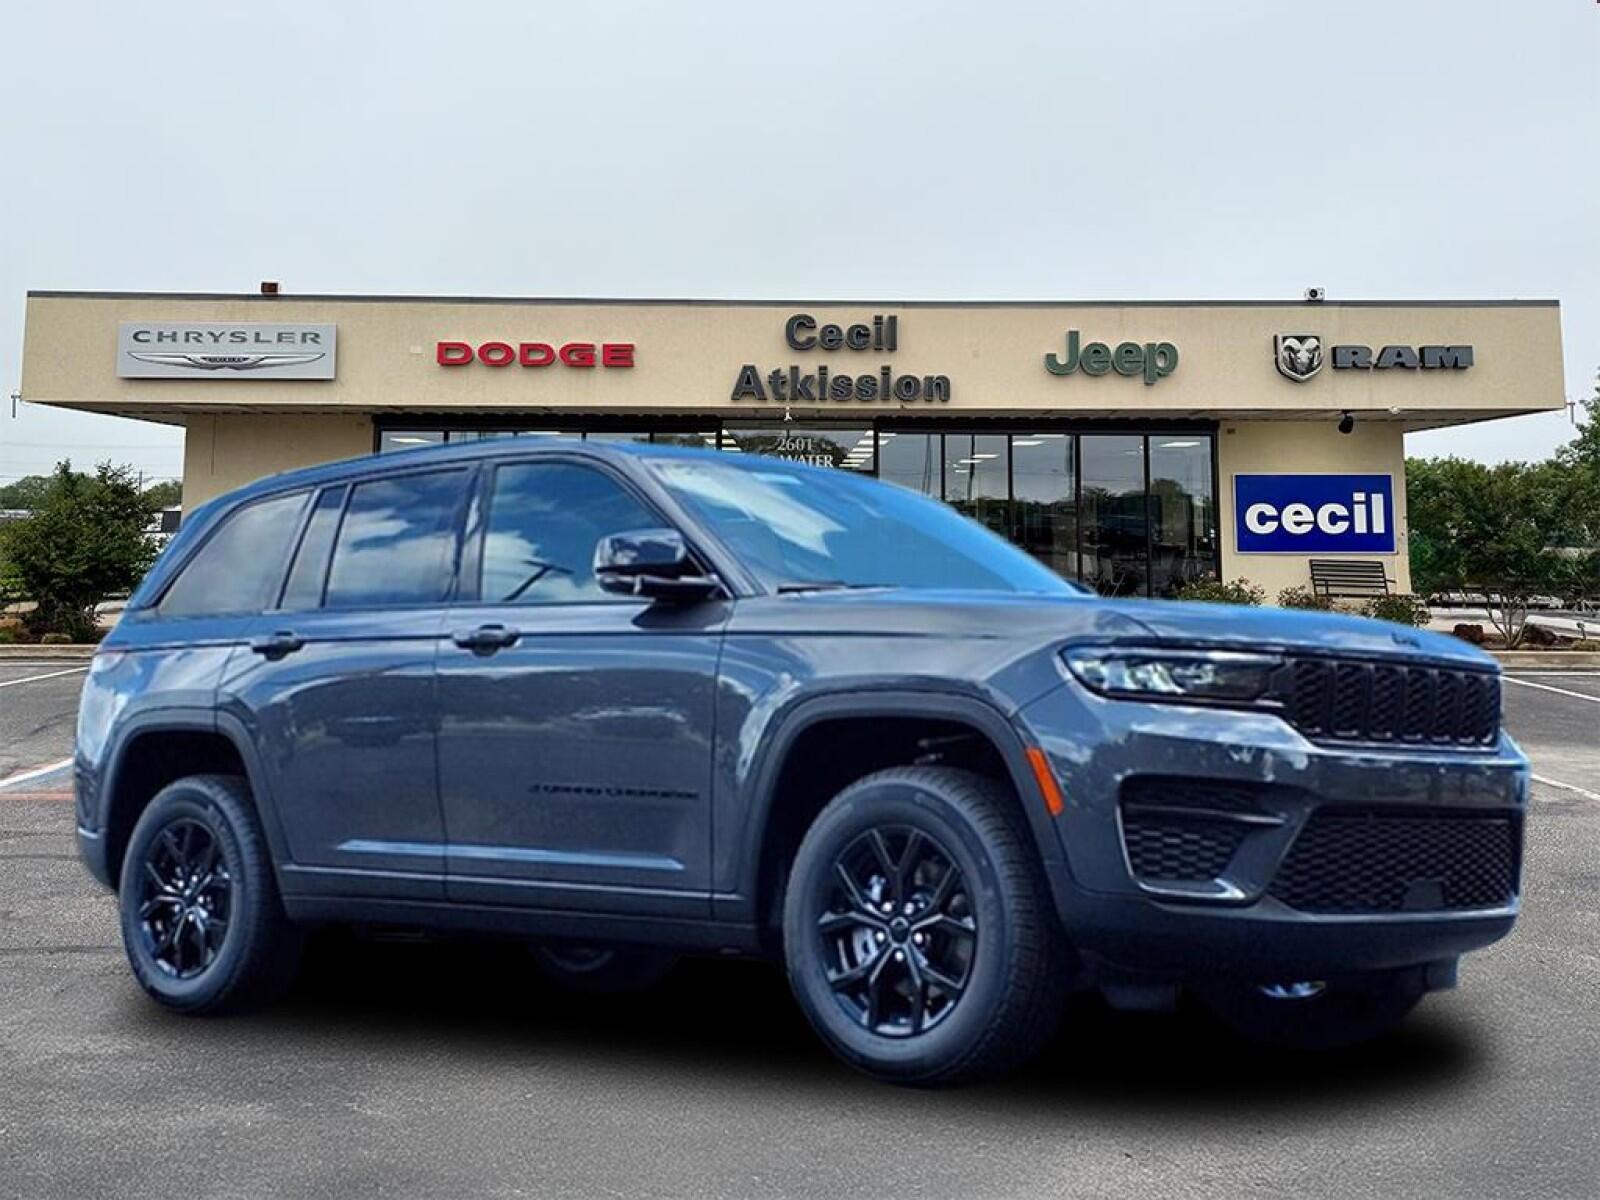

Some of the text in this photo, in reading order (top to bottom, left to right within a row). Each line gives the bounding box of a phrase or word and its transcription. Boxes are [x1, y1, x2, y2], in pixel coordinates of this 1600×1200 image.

[132, 328, 323, 346] CHRYSLER
[785, 313, 898, 351] Cecil
[436, 341, 635, 368] DODGE
[1044, 329, 1179, 385] Jeep
[1332, 344, 1474, 370] RAM
[731, 364, 951, 401] Atkission
[777, 436, 812, 451] 2601
[1244, 492, 1385, 534] cecil
